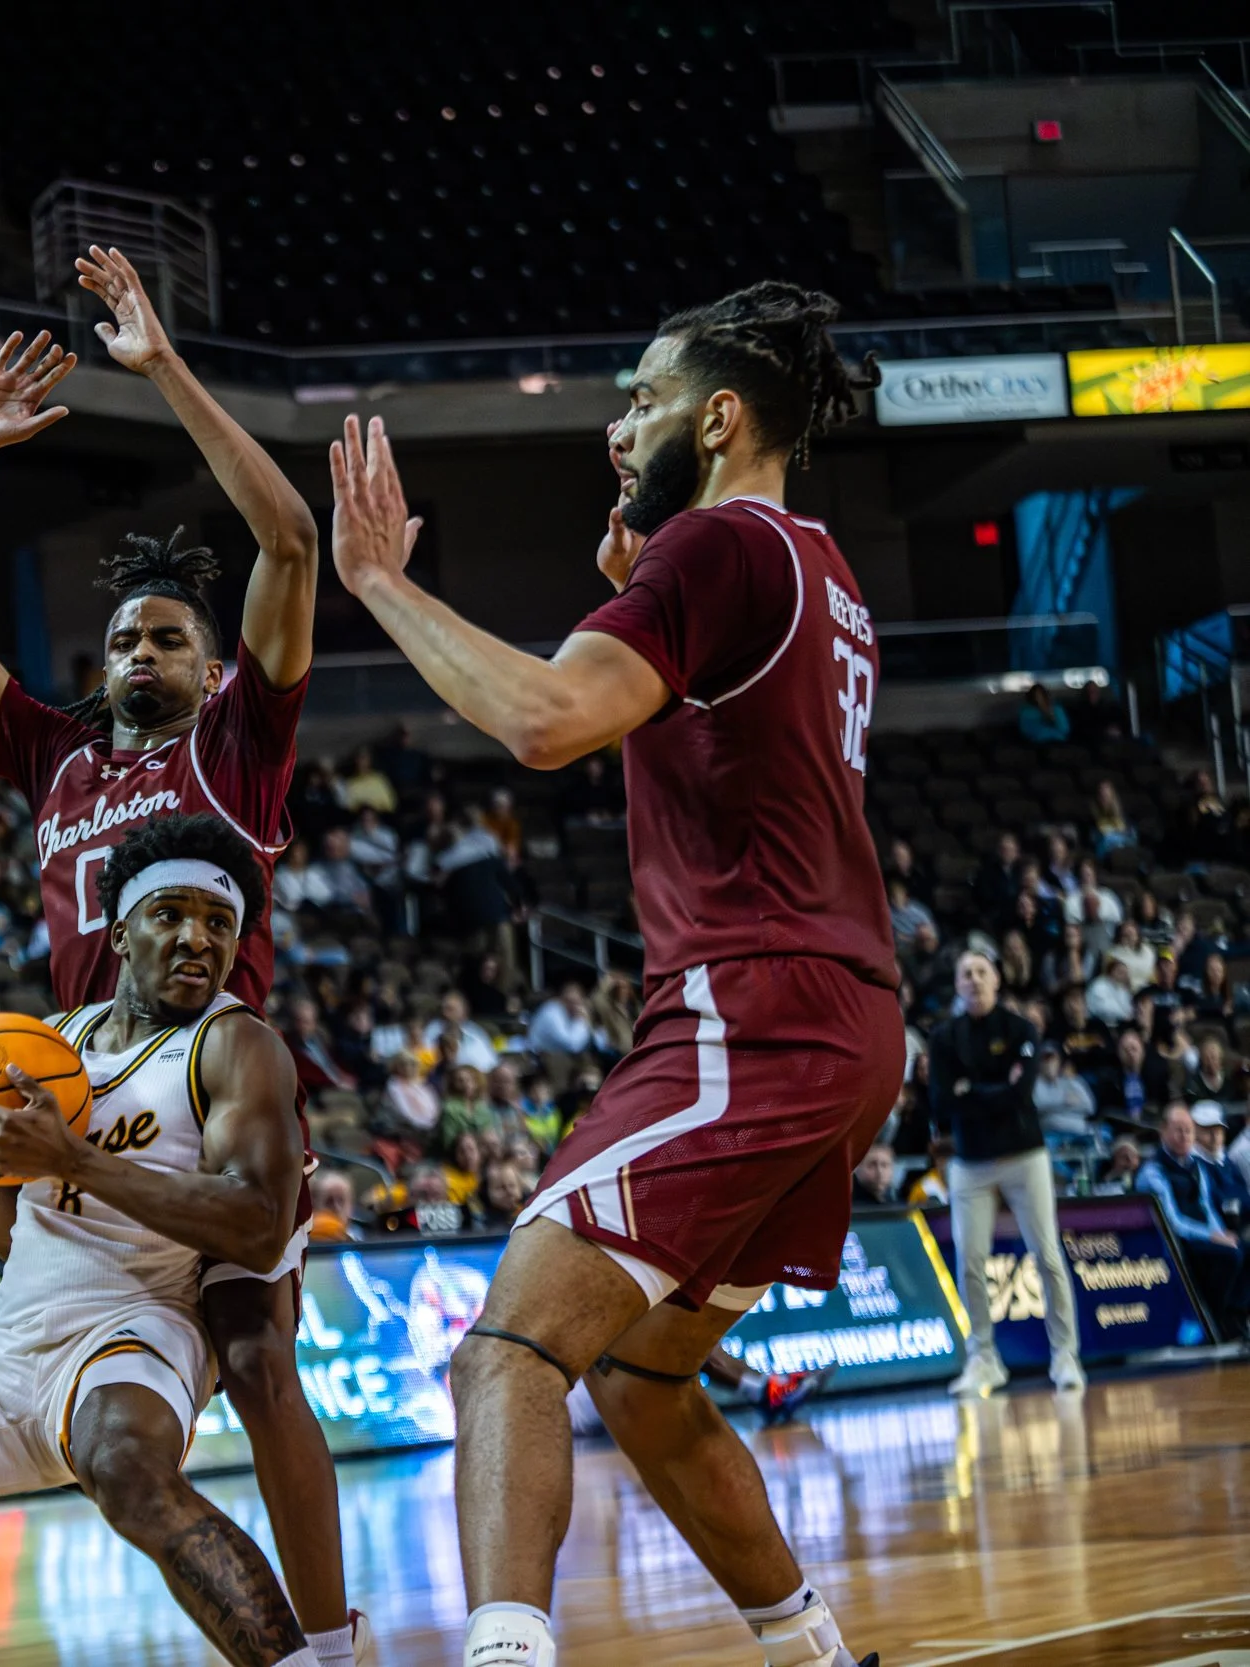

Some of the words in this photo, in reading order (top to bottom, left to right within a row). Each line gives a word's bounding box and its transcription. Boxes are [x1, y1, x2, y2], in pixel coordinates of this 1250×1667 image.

[825, 576, 874, 646] REEVES
[833, 636, 874, 777] 32
[38, 790, 180, 870] Charleston
